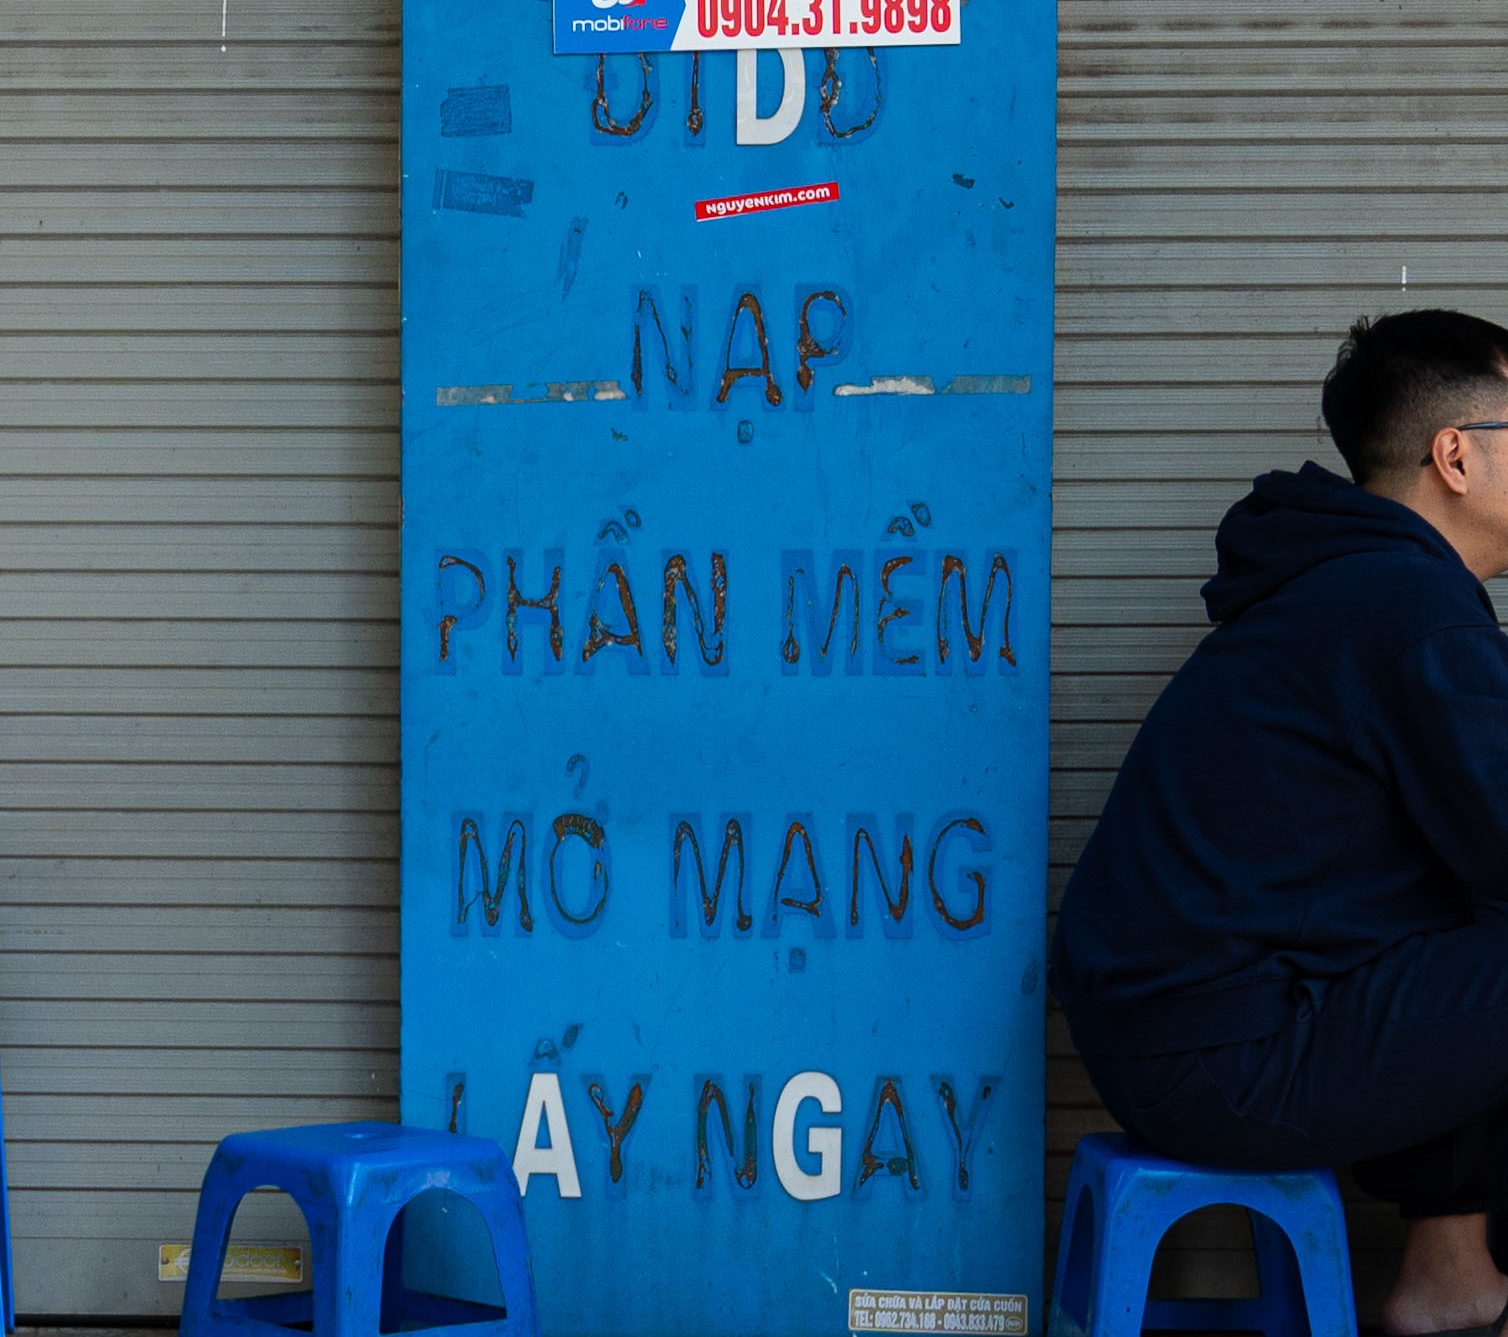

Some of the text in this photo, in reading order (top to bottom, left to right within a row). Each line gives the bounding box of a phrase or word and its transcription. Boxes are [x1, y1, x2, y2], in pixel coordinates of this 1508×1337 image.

[572, 14, 669, 33] mobifone
[692, 1070, 1002, 1202] NGAY
[854, 1310, 873, 1328] TEL:
